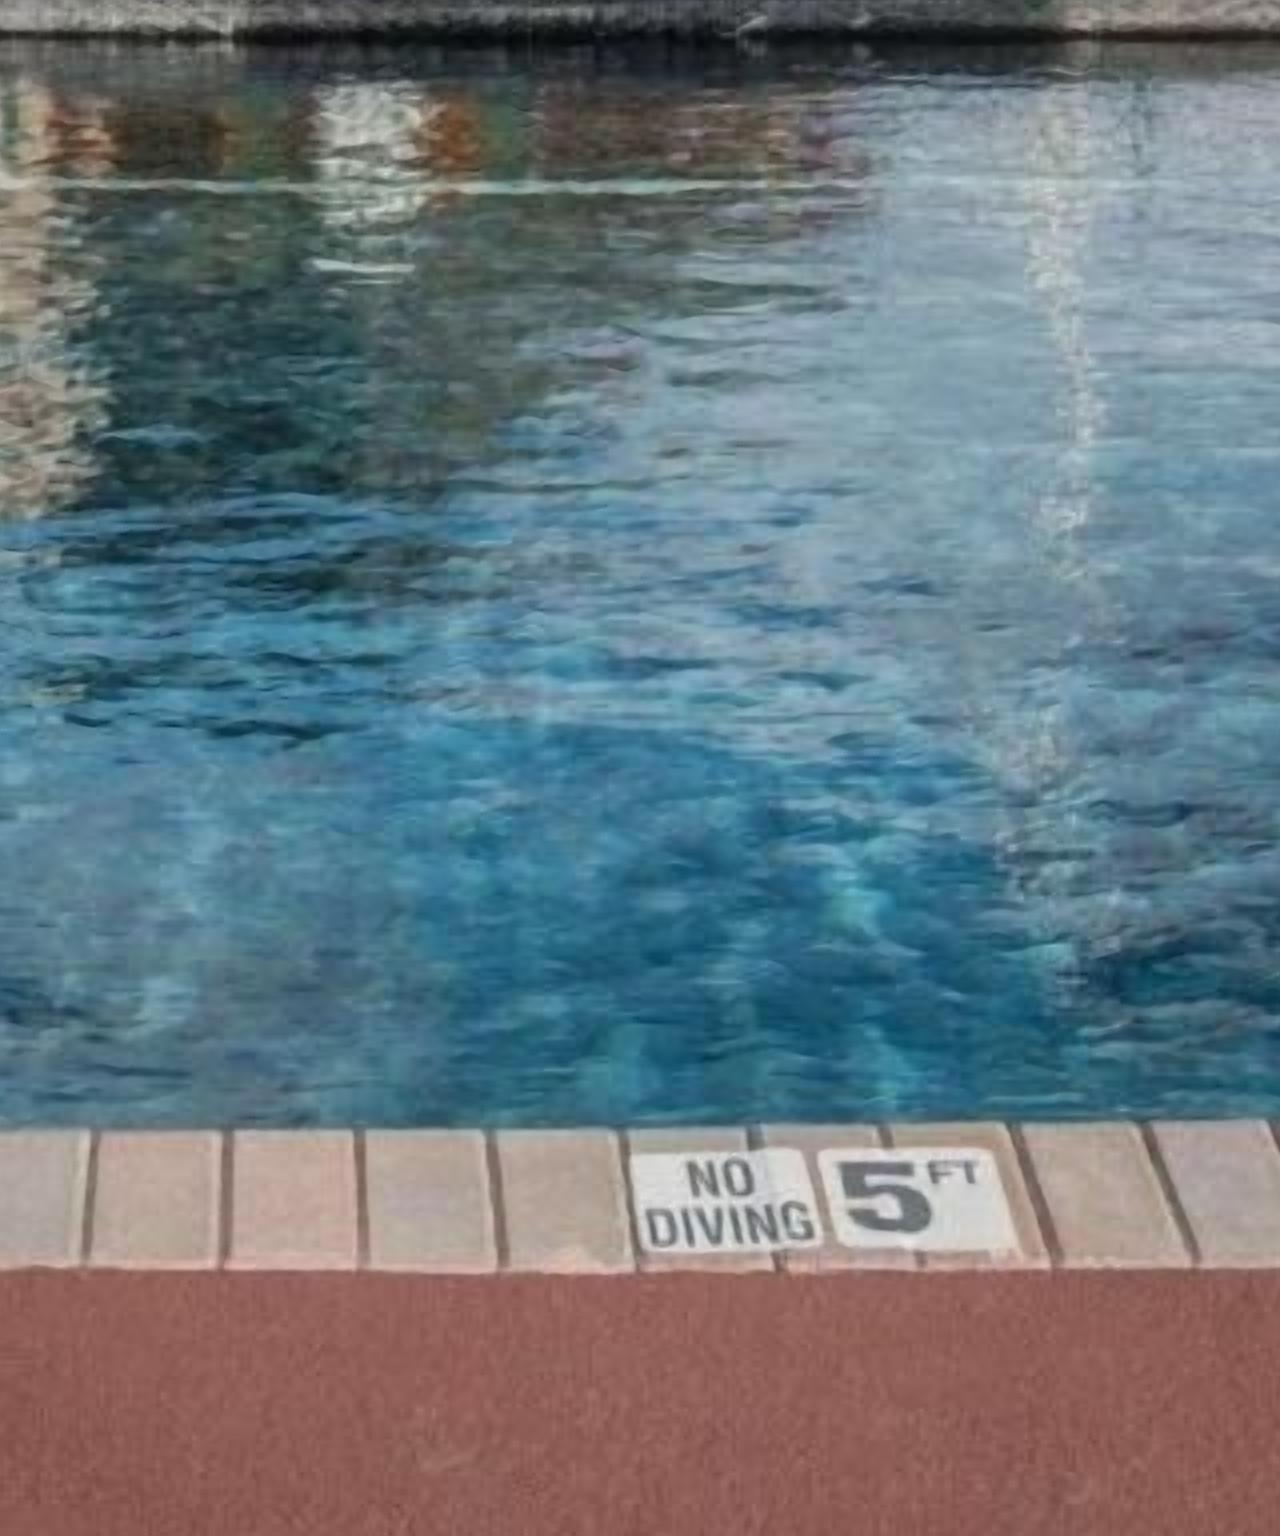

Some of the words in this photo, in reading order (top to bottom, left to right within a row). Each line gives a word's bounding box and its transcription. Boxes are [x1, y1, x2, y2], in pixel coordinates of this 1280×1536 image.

[686, 1158, 755, 1198] NO
[837, 1161, 933, 1233] 5
[927, 1160, 980, 1185] FT
[646, 1200, 816, 1248] DIVING
